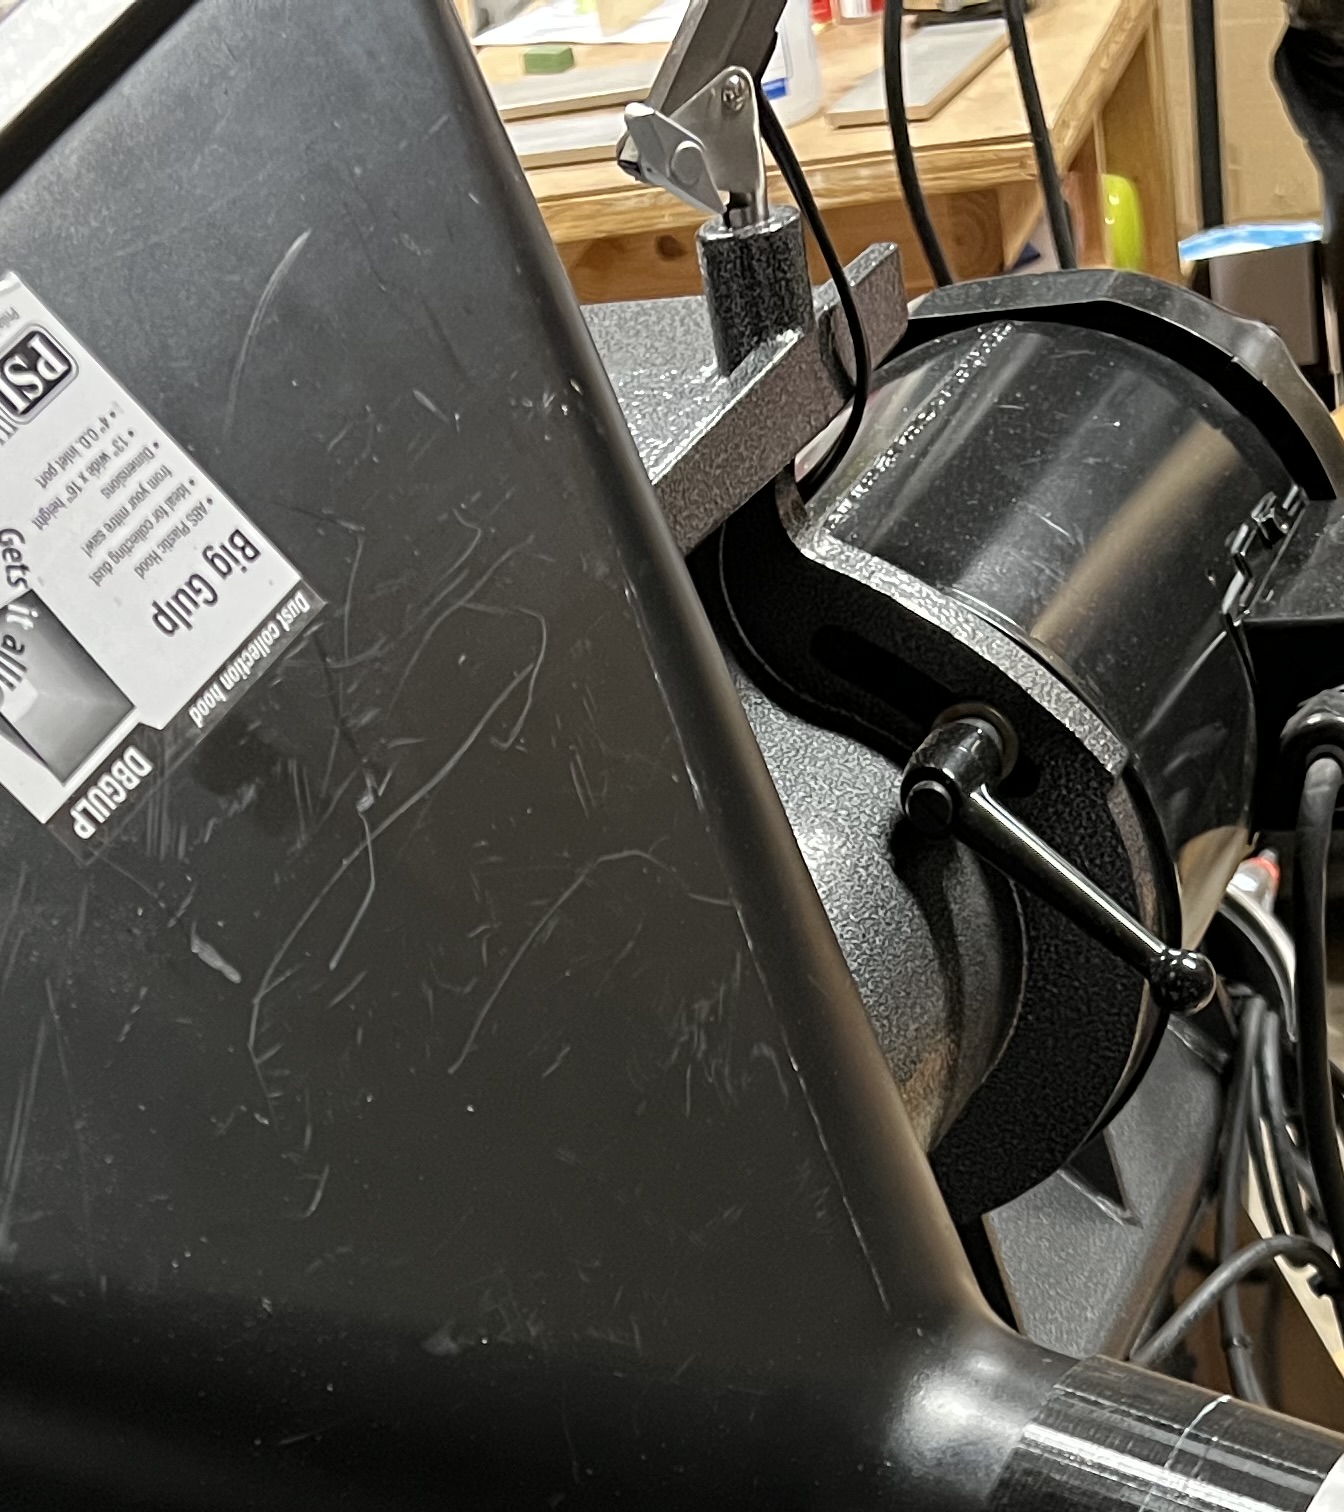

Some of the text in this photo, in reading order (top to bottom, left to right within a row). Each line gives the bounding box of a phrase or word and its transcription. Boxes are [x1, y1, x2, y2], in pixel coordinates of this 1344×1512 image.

[54, 444, 81, 471] inlet
[85, 451, 111, 476] wide
[100, 446, 155, 500] Dimensions
[34, 462, 59, 489] port
[146, 464, 173, 490] from
[127, 482, 151, 511] your
[31, 496, 67, 531] height
[103, 505, 130, 533] mitre
[88, 483, 192, 587] Ideal for collecting dust
[133, 500, 208, 580] ABS Plastic Hood
[151, 528, 261, 636] Big Gulp
[6, 603, 39, 631] it
[189, 590, 311, 728] Dust collection hood
[70, 746, 152, 839] DBGULP
